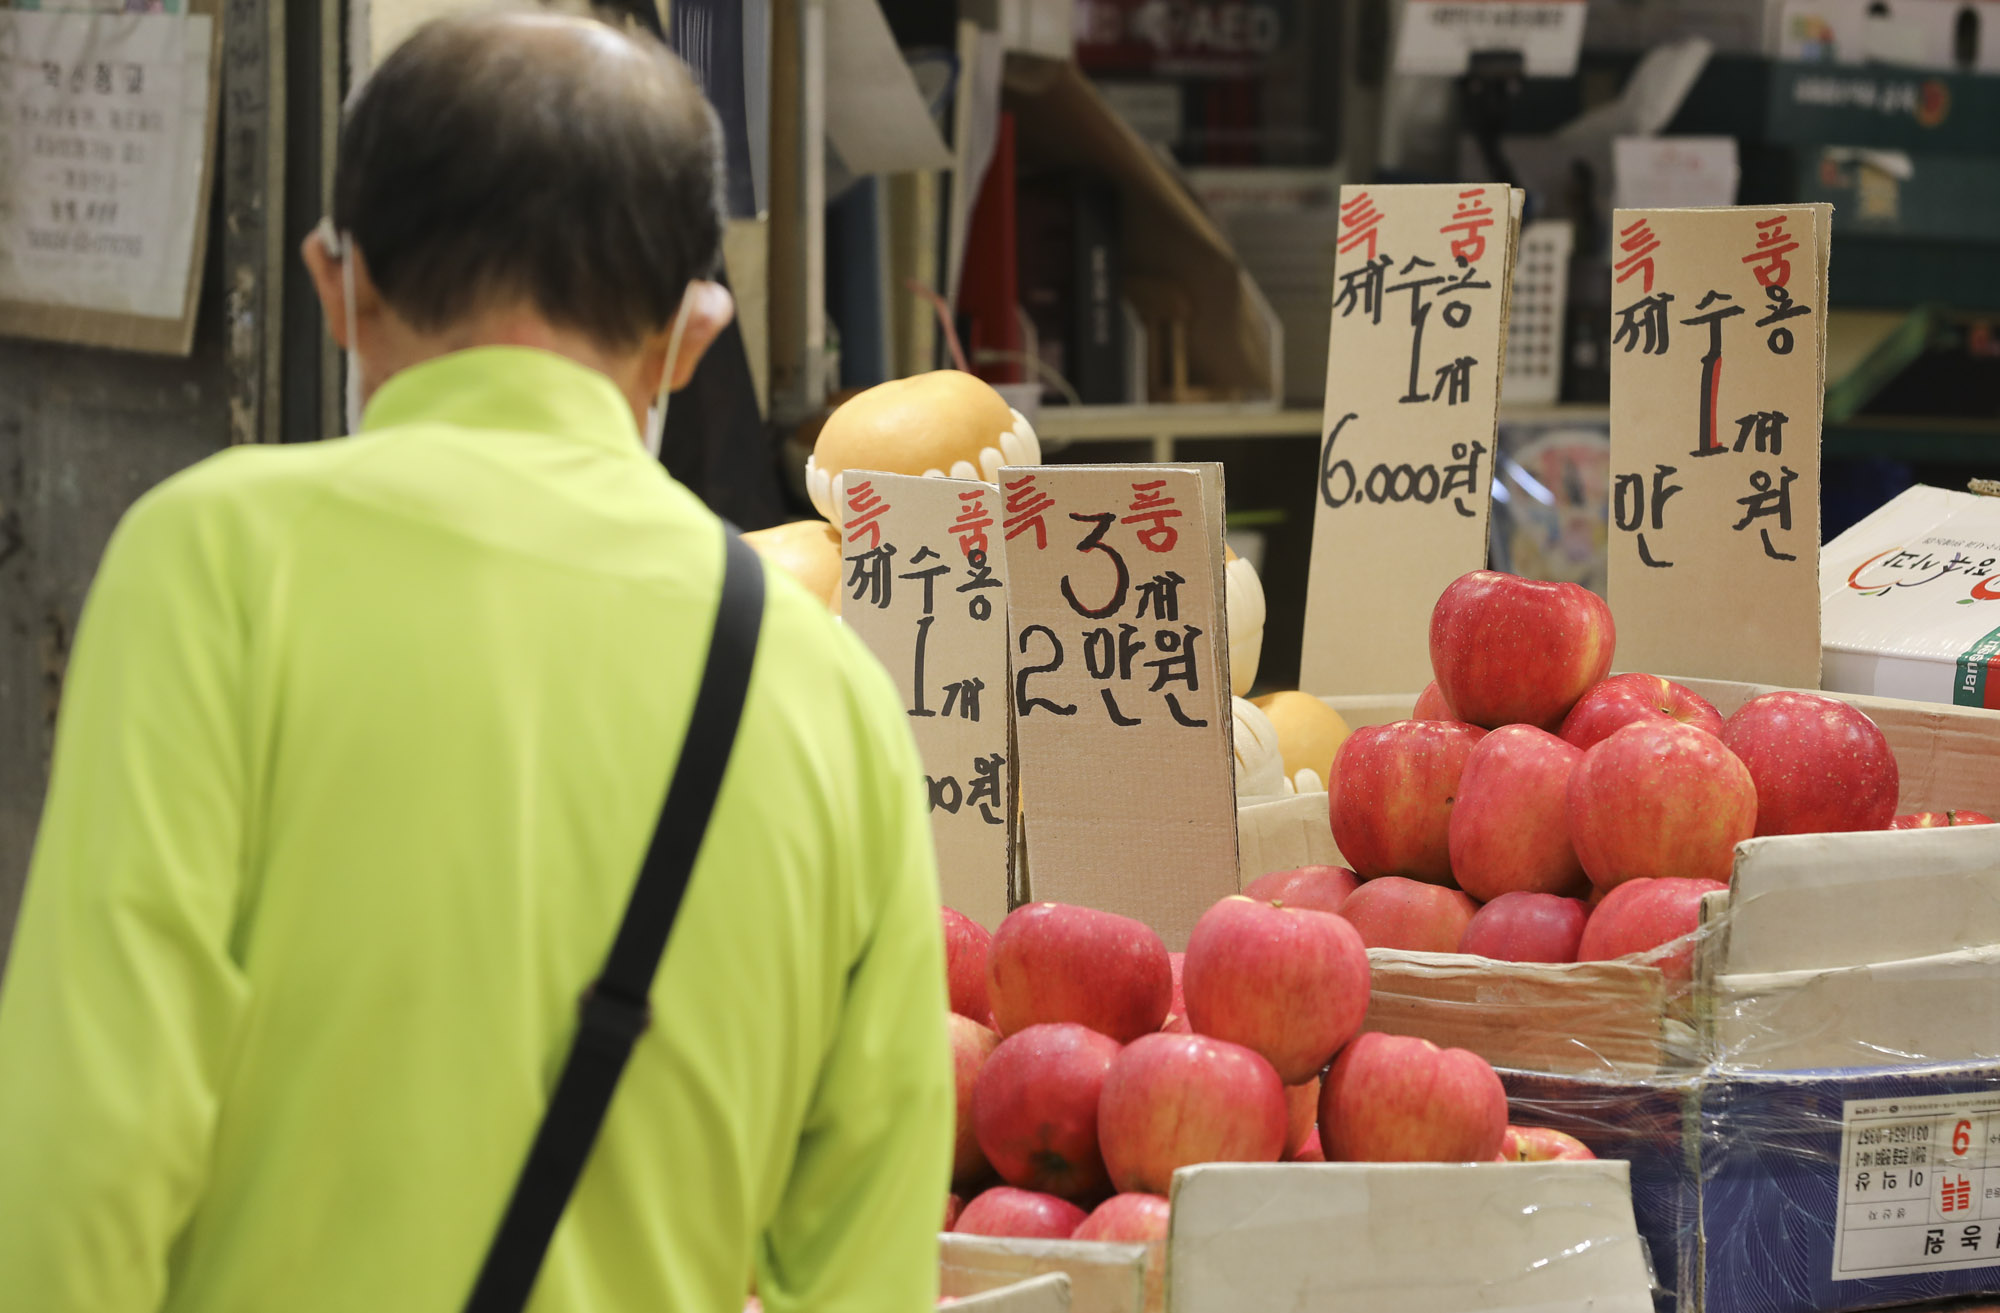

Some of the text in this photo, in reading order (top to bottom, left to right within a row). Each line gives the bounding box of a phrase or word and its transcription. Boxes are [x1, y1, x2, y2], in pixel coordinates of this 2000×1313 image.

[1337, 188, 1495, 263] 특 품
[1613, 215, 1800, 294] 특 품
[1333, 254, 1492, 328] 제수용
[1612, 285, 1812, 358] 제수용
[1398, 302, 1479, 405] 1개
[1689, 355, 1790, 457] 1개
[1320, 412, 1487, 517] 6.000원
[844, 480, 995, 562] 특 품
[1002, 474, 1183, 553] 특 품
[844, 542, 1004, 622] 제수용
[1060, 512, 1186, 620] 3개
[1882, 552, 1996, 577] 장수사과
[906, 615, 985, 723] 1개
[1015, 622, 1208, 728] 2만원
[1855, 1169, 1924, 1192] 이익상
[1924, 1224, 2000, 1256] 농원
